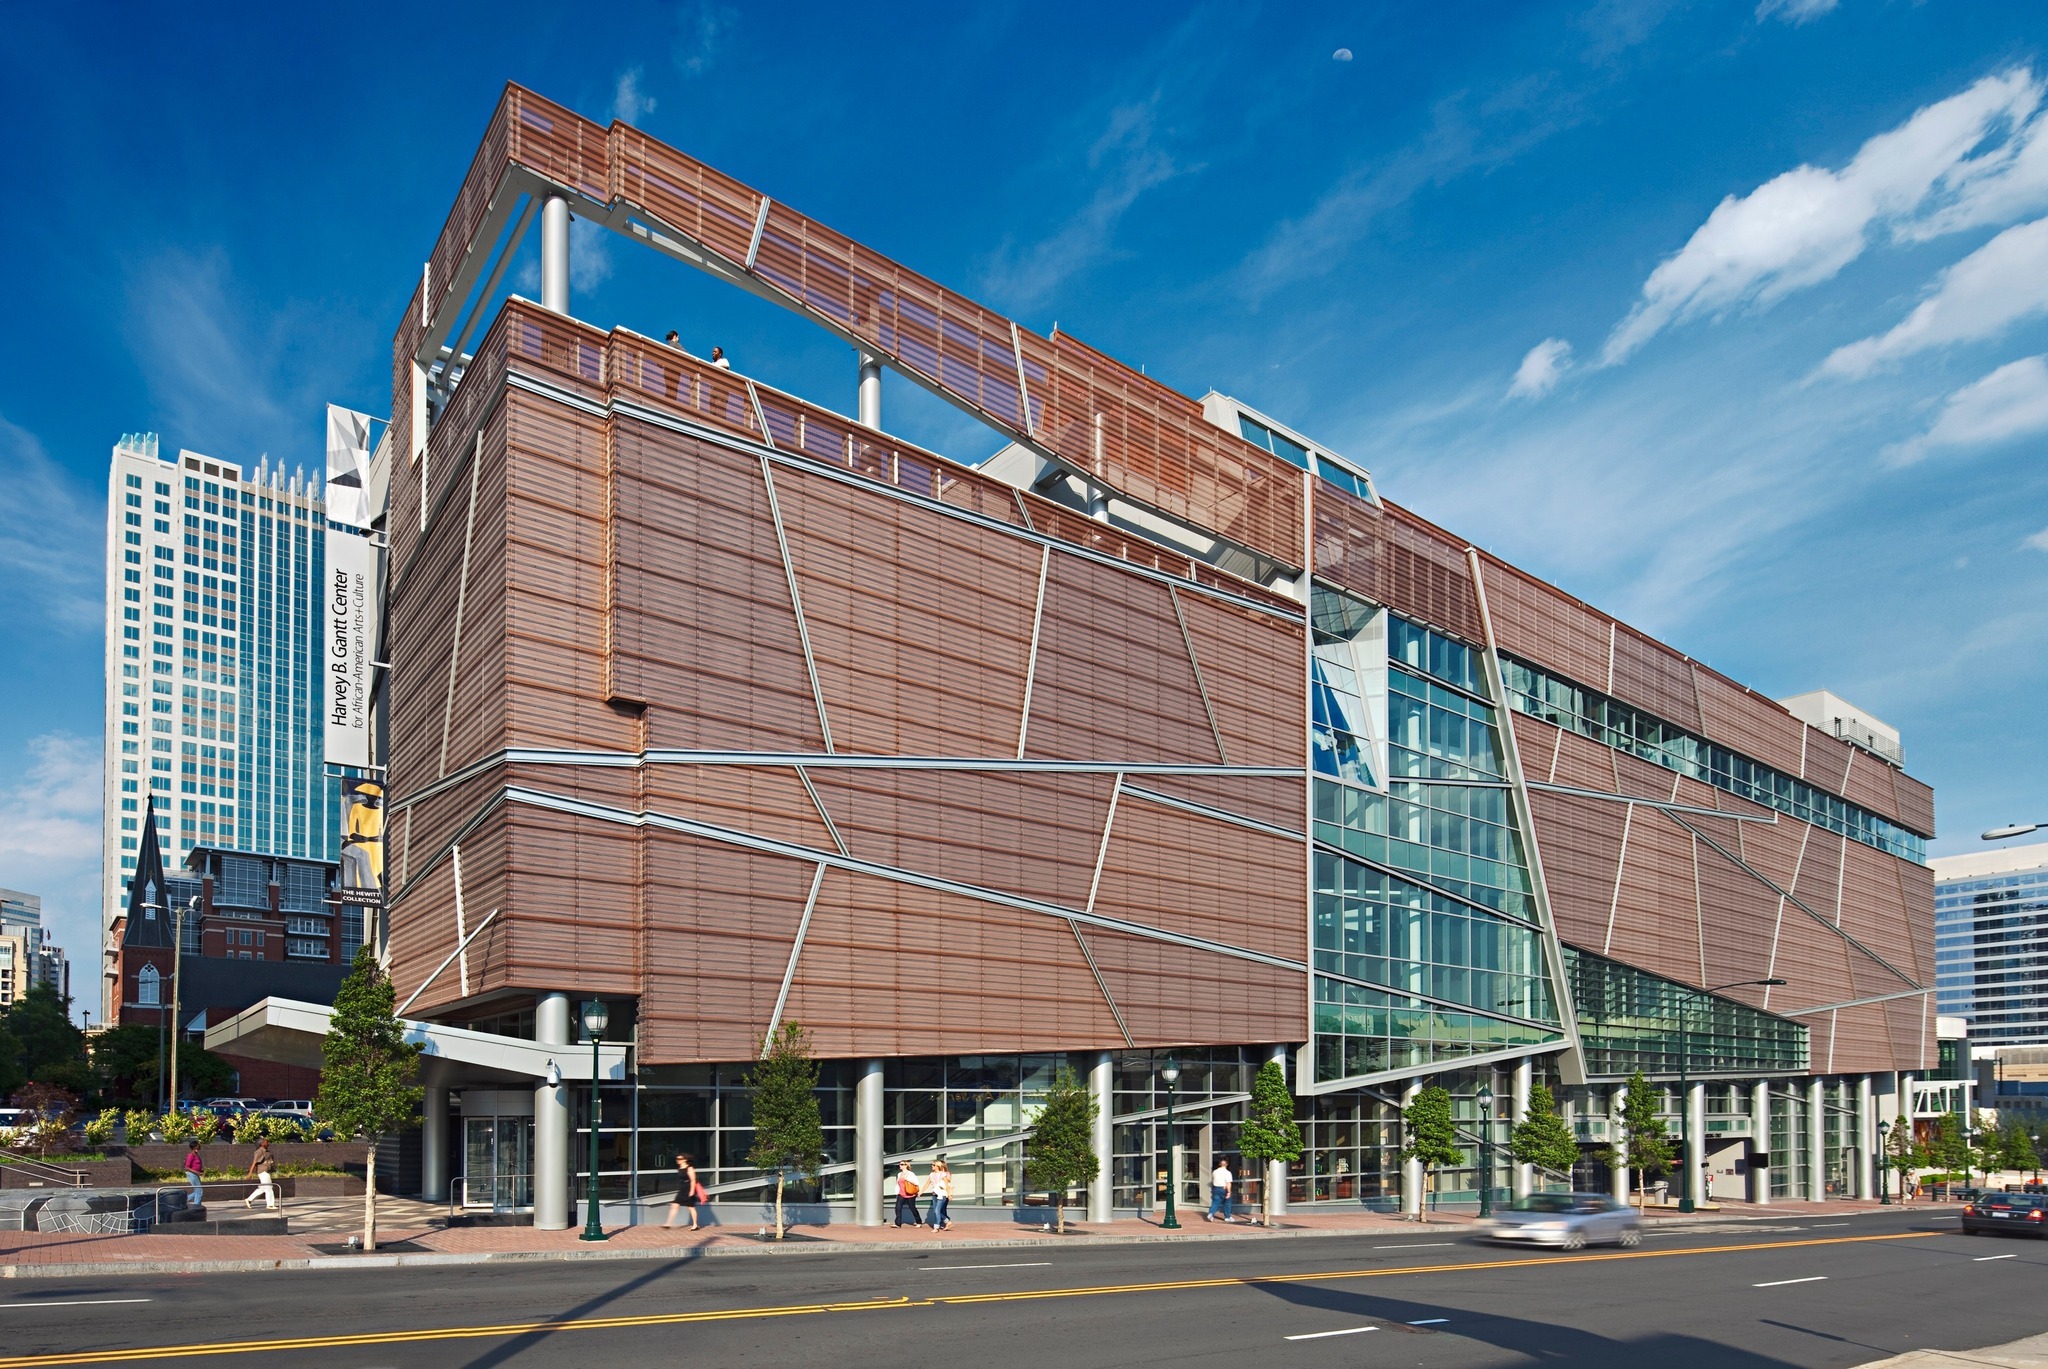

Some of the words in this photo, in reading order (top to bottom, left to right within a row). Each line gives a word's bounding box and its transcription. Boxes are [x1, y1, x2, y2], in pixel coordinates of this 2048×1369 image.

[331, 568, 348, 616] Center
[352, 573, 364, 634] Arts+Culture
[331, 618, 348, 658] Gantt
[331, 661, 347, 674] B.
[352, 635, 364, 715] African-American
[331, 675, 351, 727] Harvey
[352, 716, 364, 729] for
[342, 896, 381, 904] COLLECTION
